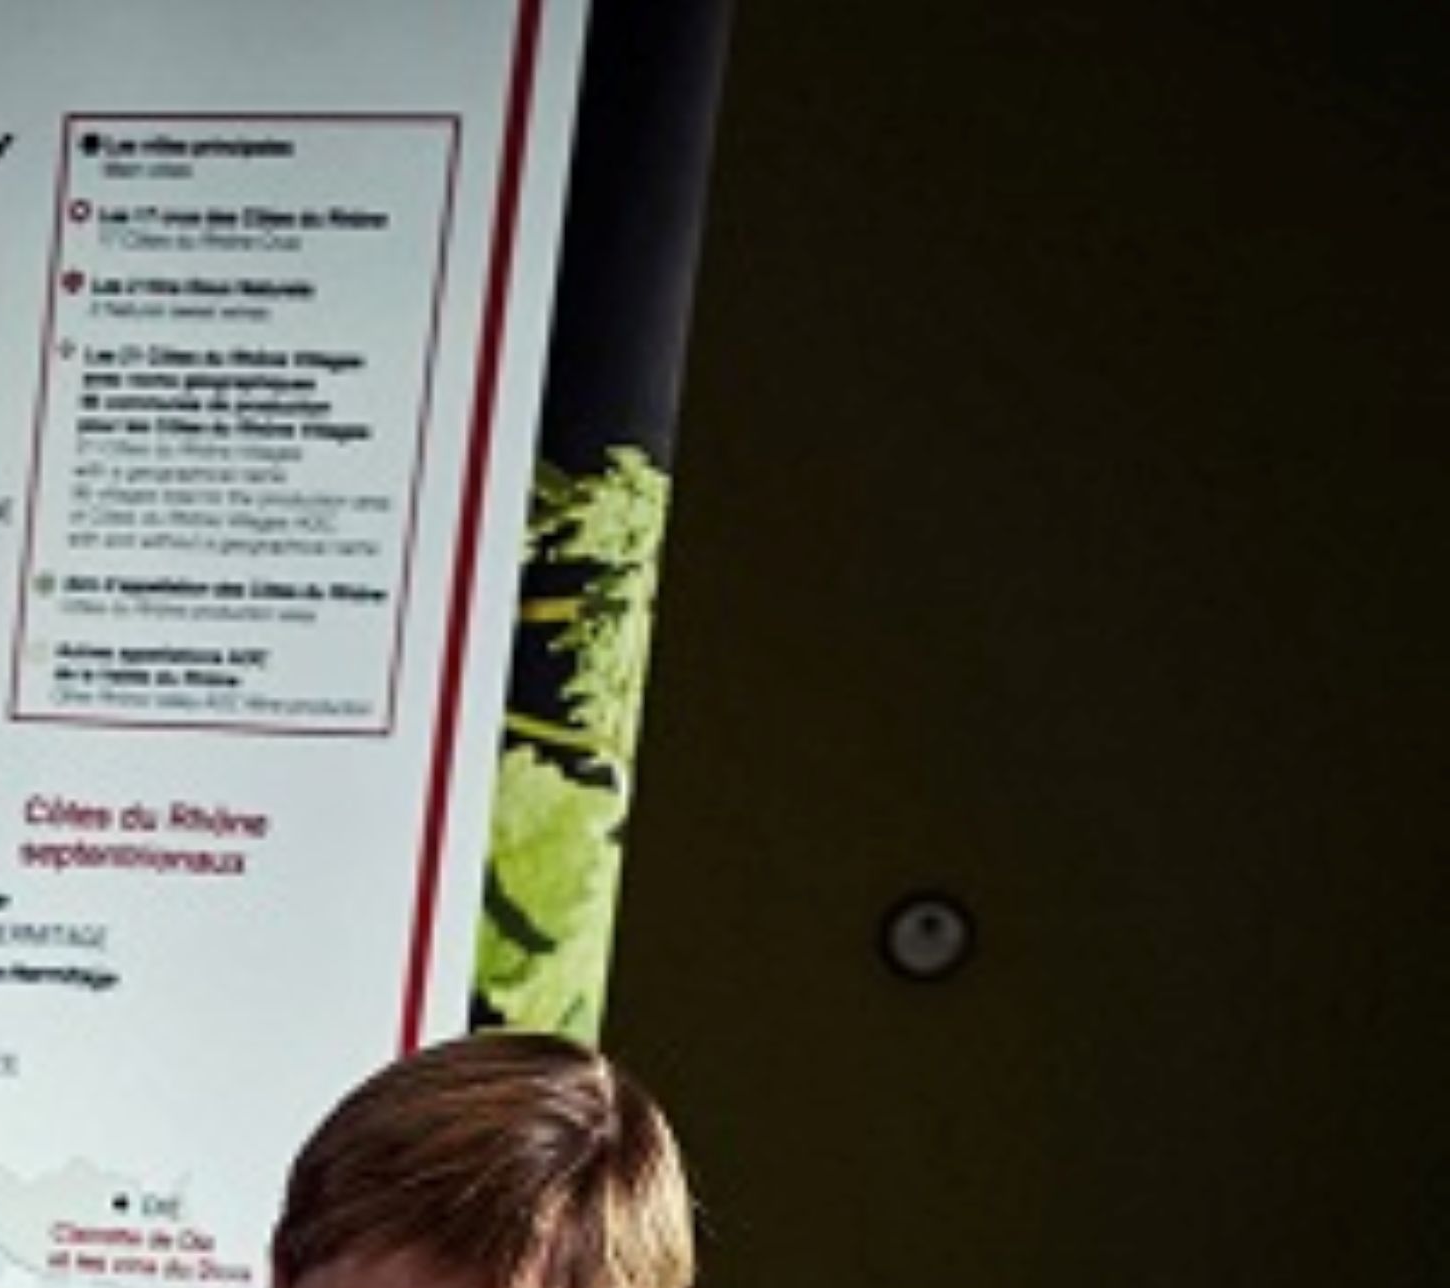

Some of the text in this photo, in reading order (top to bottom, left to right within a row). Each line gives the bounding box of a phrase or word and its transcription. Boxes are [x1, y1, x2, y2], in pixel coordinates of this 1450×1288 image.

[24, 794, 269, 840] Côtes du Rhône
